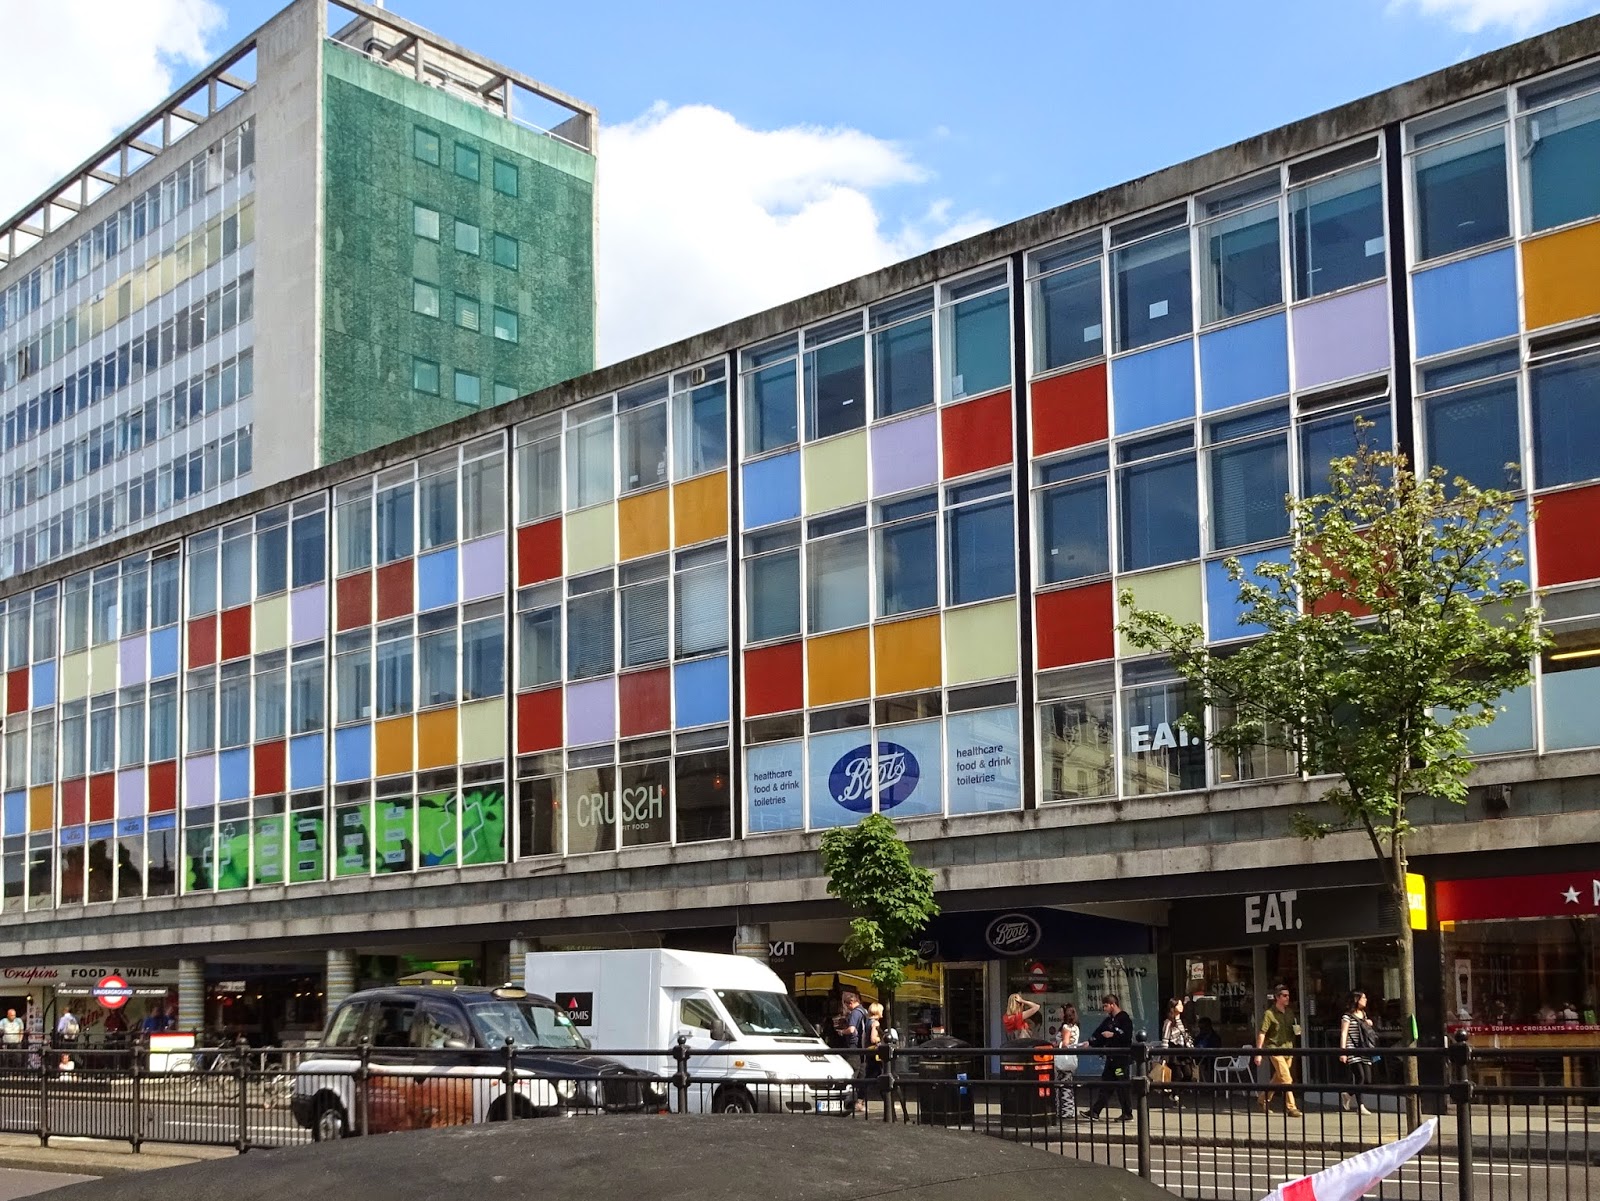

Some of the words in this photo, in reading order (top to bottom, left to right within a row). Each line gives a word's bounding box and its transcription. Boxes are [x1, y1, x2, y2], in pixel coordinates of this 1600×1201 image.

[956, 743, 1004, 759] healthcare
[956, 760, 978, 772] food
[979, 758, 986, 769] &
[988, 754, 1012, 767] drink
[753, 768, 793, 782] healthcare
[956, 772, 996, 786] toiletries
[753, 783, 772, 794] food
[772, 784, 779, 792] &
[780, 780, 800, 791] drink
[577, 784, 663, 828] CRUSSH
[753, 795, 787, 807] toiletries
[632, 822, 650, 830] FOOD
[1245, 890, 1303, 934] EAT.
[993, 922, 1029, 945] Boots
[3, 966, 59, 985] Crispins
[71, 968, 107, 978] FOOD
[113, 967, 121, 977] &
[126, 967, 160, 977] WINE
[1211, 981, 1247, 996] SEATS
[563, 1010, 589, 1020] OMIS
